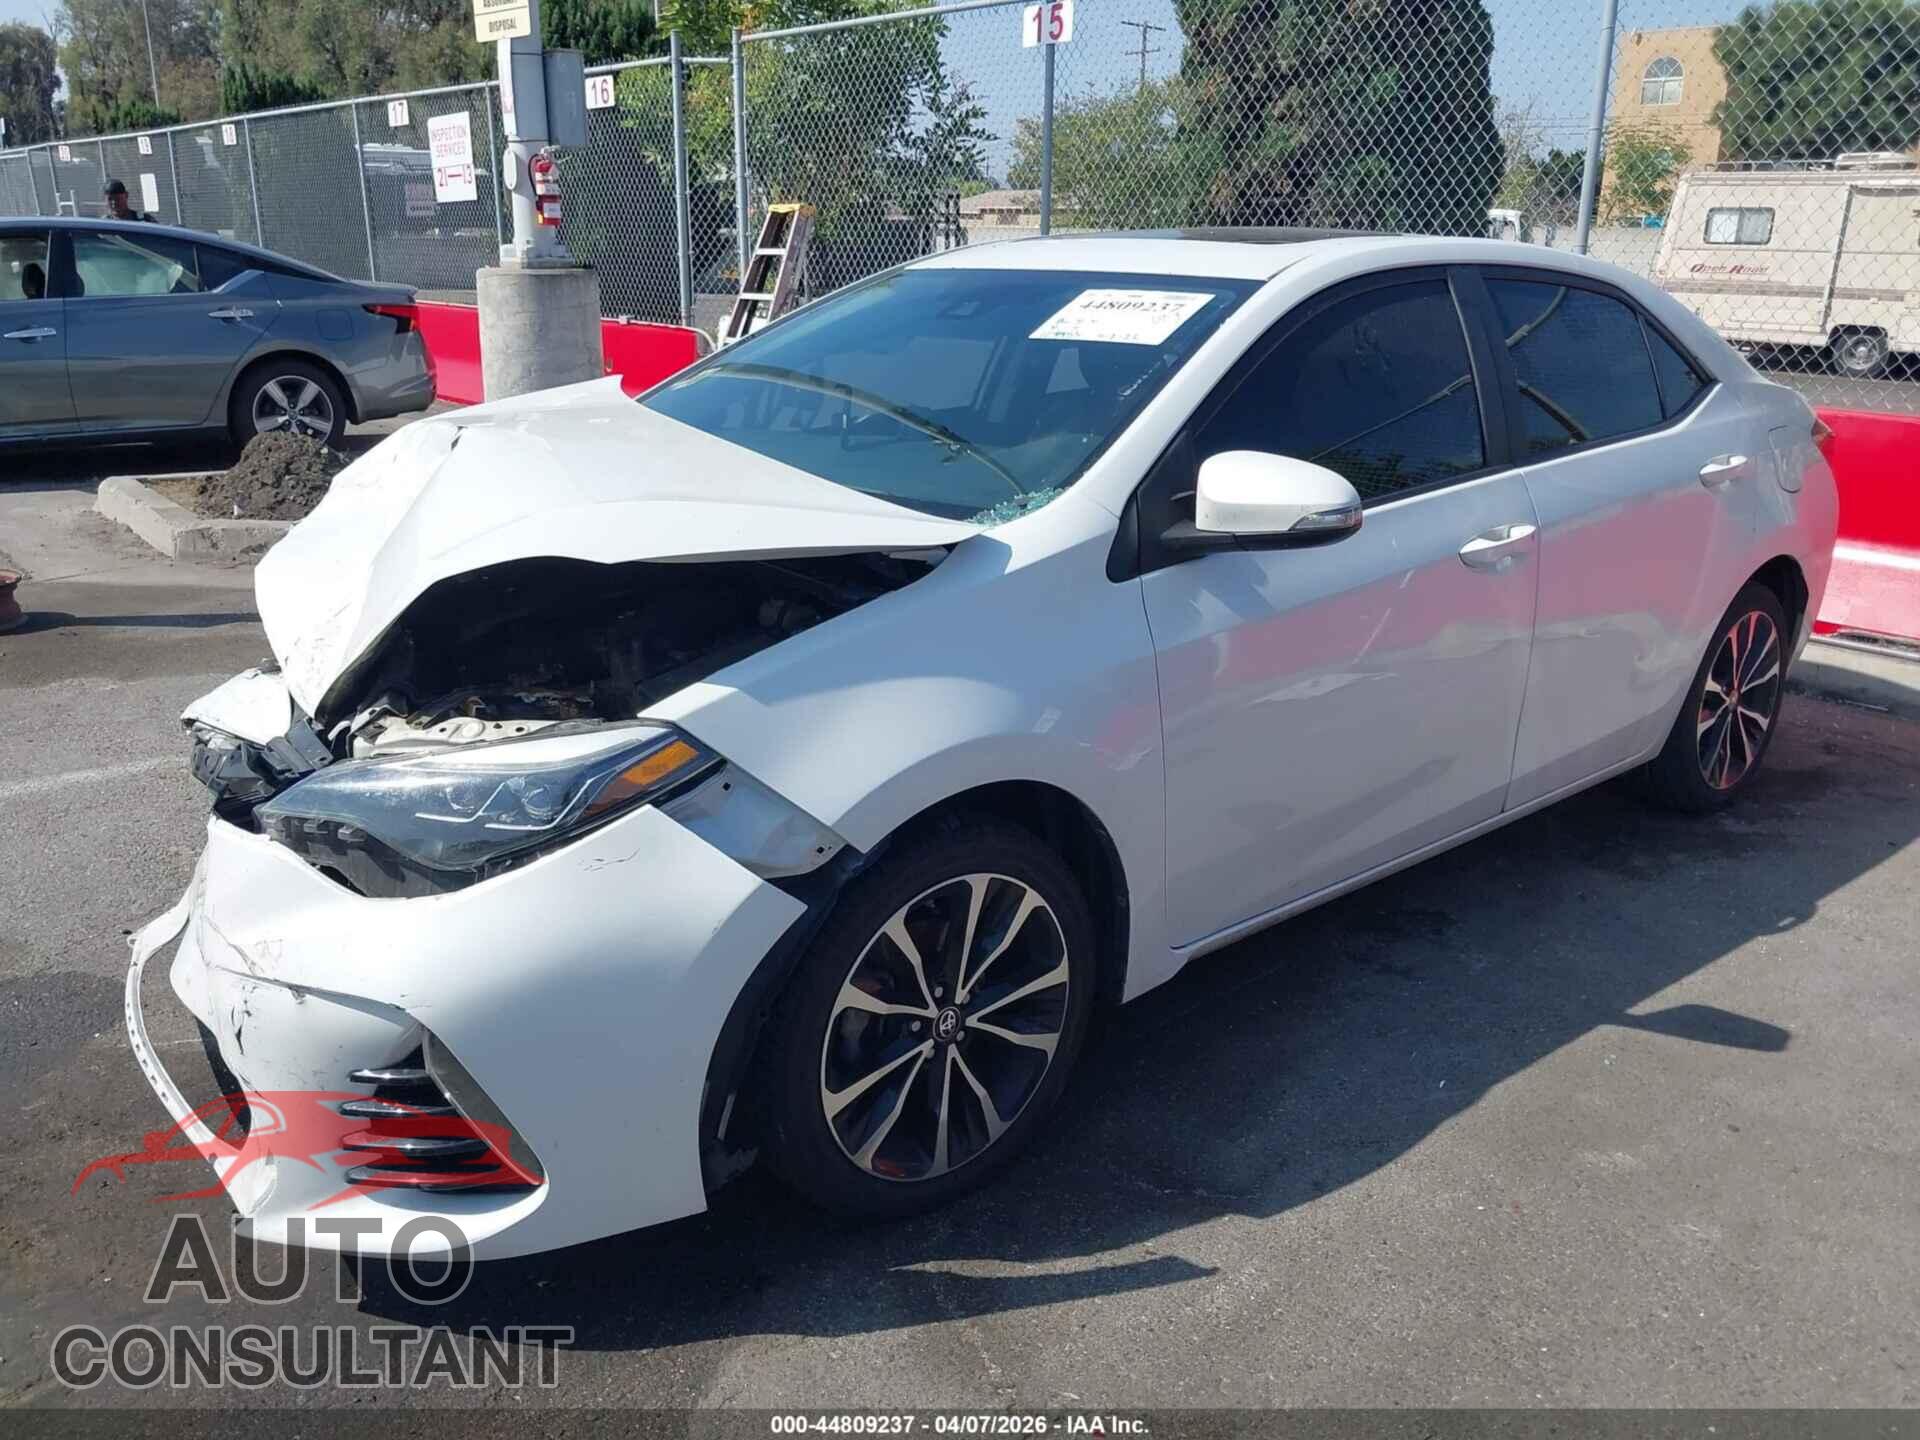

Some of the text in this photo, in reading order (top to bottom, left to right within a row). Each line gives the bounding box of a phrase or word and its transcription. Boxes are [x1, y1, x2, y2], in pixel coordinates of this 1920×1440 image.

[1033, 3, 1063, 43] 15
[592, 78, 610, 105] 16
[392, 102, 405, 125] 17
